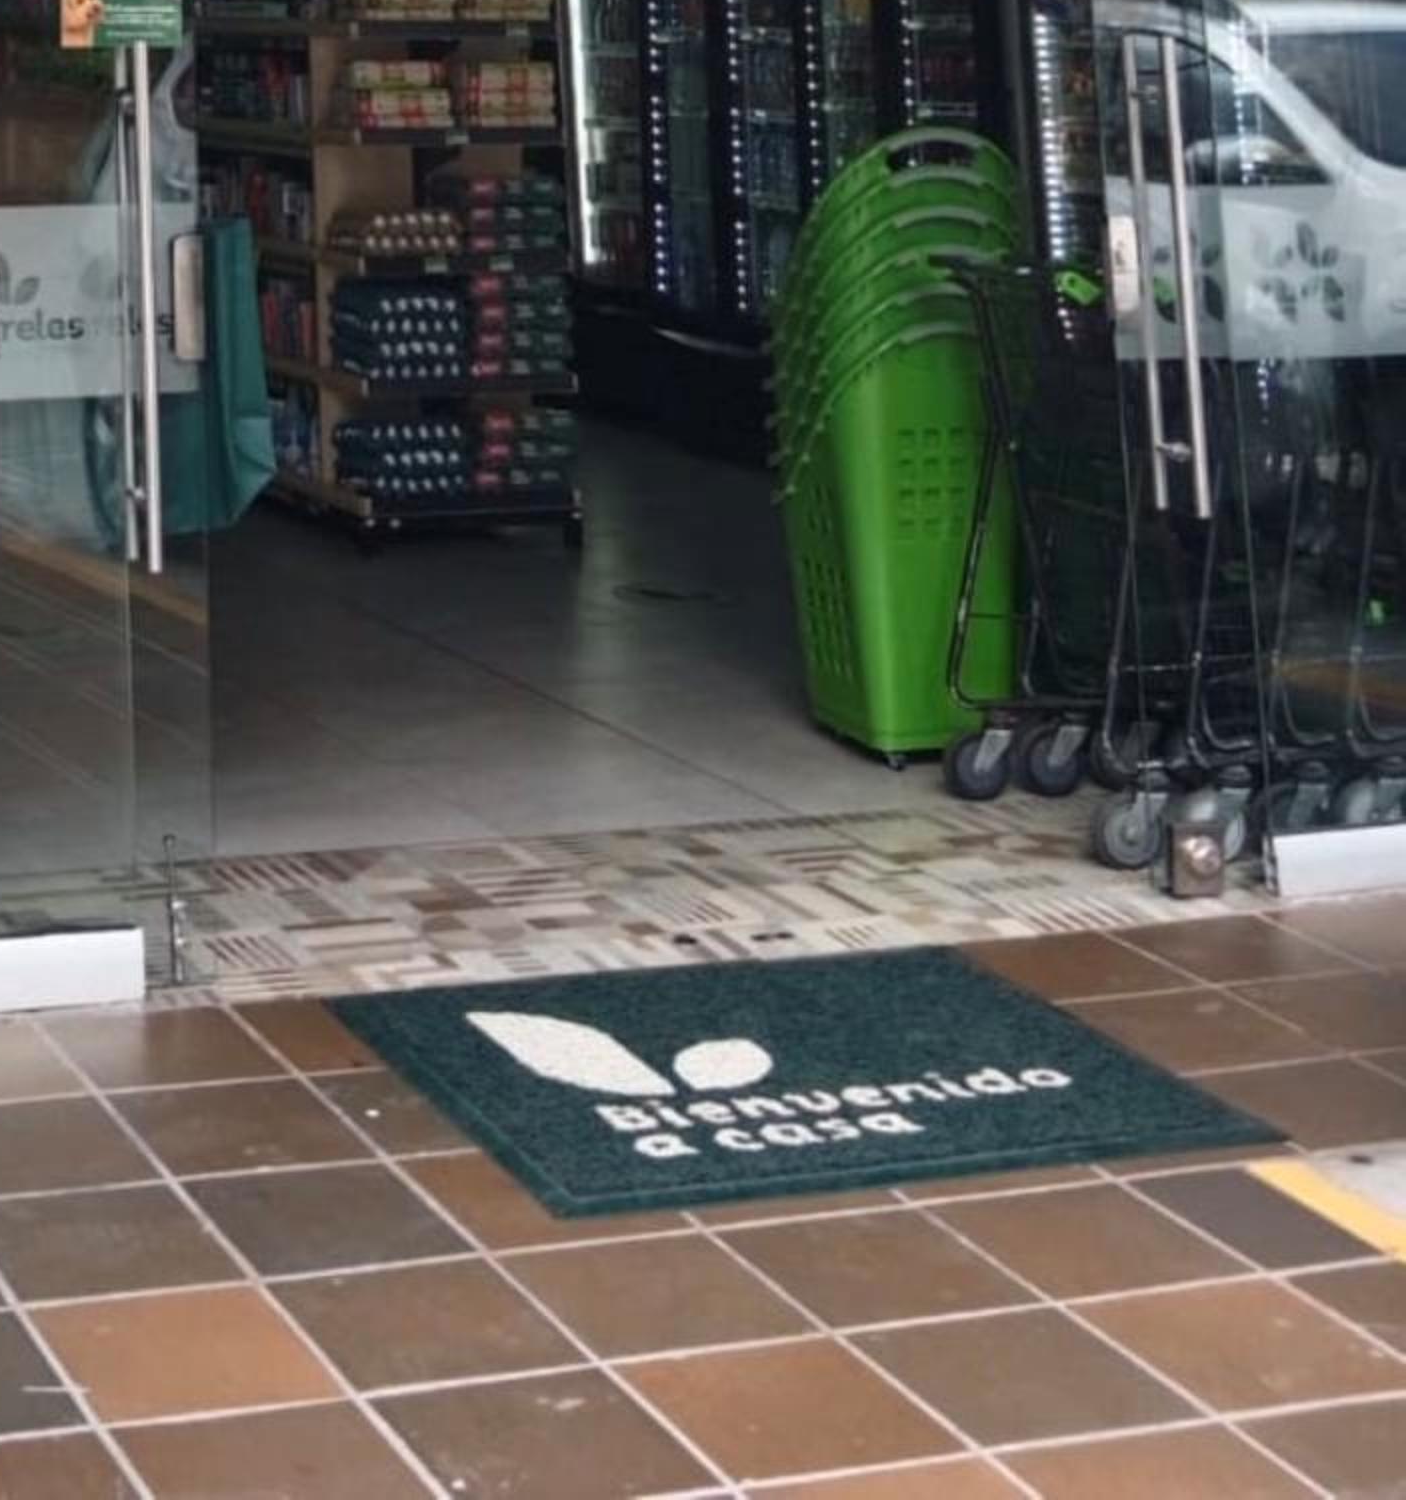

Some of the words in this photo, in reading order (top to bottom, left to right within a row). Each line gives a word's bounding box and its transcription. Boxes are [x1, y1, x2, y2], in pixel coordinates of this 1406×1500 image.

[595, 1065, 1073, 1131] Bienvenido
[633, 1132, 700, 1159] a
[713, 1111, 926, 1152] casa
